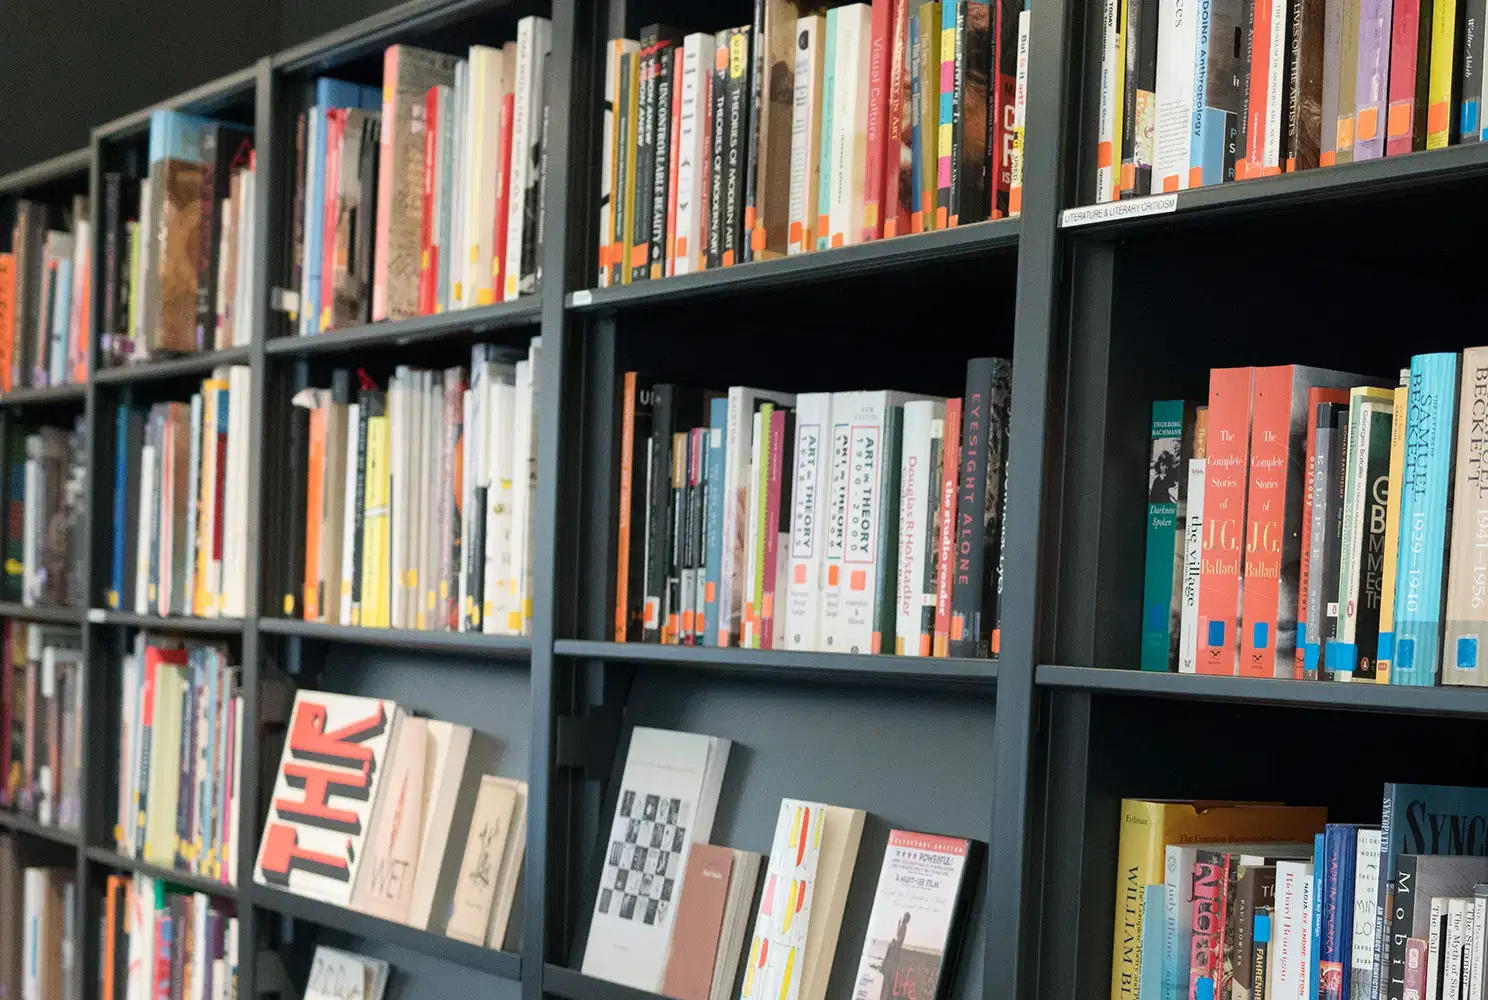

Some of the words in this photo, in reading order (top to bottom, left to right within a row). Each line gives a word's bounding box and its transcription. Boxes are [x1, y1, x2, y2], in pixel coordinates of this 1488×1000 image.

[1200, 0, 1210, 44] DOING
[1291, 4, 1301, 36] LIVES
[1466, 18, 1475, 48] Walter
[871, 36, 884, 82] Visual
[1290, 39, 1300, 56] OF
[1464, 50, 1473, 78] Abish
[1194, 49, 1207, 136] Anthropology
[1290, 59, 1298, 84] THE
[714, 96, 724, 154] THEORIES
[730, 88, 740, 147] THEORIES
[868, 86, 880, 140] Culture
[1288, 88, 1298, 136] ARTISTS
[653, 82, 669, 196] UNCONTROLLABLE
[728, 150, 738, 166] OF
[714, 156, 722, 172] OF
[711, 174, 720, 229] MODERN
[725, 168, 736, 224] MODERN
[1065, 210, 1104, 223] LITERATURE
[1104, 208, 1109, 218] &
[1110, 203, 1140, 217] LITERARY
[1141, 199, 1174, 211] CRITICISM
[652, 197, 664, 242] BEAUTY
[724, 226, 734, 250] ART
[710, 231, 719, 256] ART
[964, 393, 981, 503] EYESIGHT
[1220, 430, 1236, 442] The
[1262, 430, 1277, 442] The
[1405, 372, 1424, 491] BECKETT
[1412, 394, 1433, 503] SAMUEL
[1468, 366, 1488, 488] BECKETT
[906, 456, 918, 518] Douglas
[944, 480, 954, 504] the
[1210, 478, 1236, 488] Stories
[1254, 478, 1280, 489] Stories
[906, 520, 914, 530] R
[940, 510, 952, 560] studio
[1188, 515, 1202, 543] the
[1202, 519, 1243, 551] J.G.
[1246, 519, 1280, 554] J.G.
[958, 513, 974, 586] ALONE
[1200, 558, 1240, 574] Ballard
[902, 533, 914, 616] Hofstadter
[938, 563, 948, 616] reader
[1184, 550, 1200, 607] village
[1380, 798, 1392, 852] SYNCOPATED
[1120, 864, 1139, 964] WILLIAM
[1282, 872, 1294, 920] Richard
[1430, 905, 1440, 924] The
[1278, 923, 1292, 982] Brautigan
[1430, 928, 1439, 954] Fall
